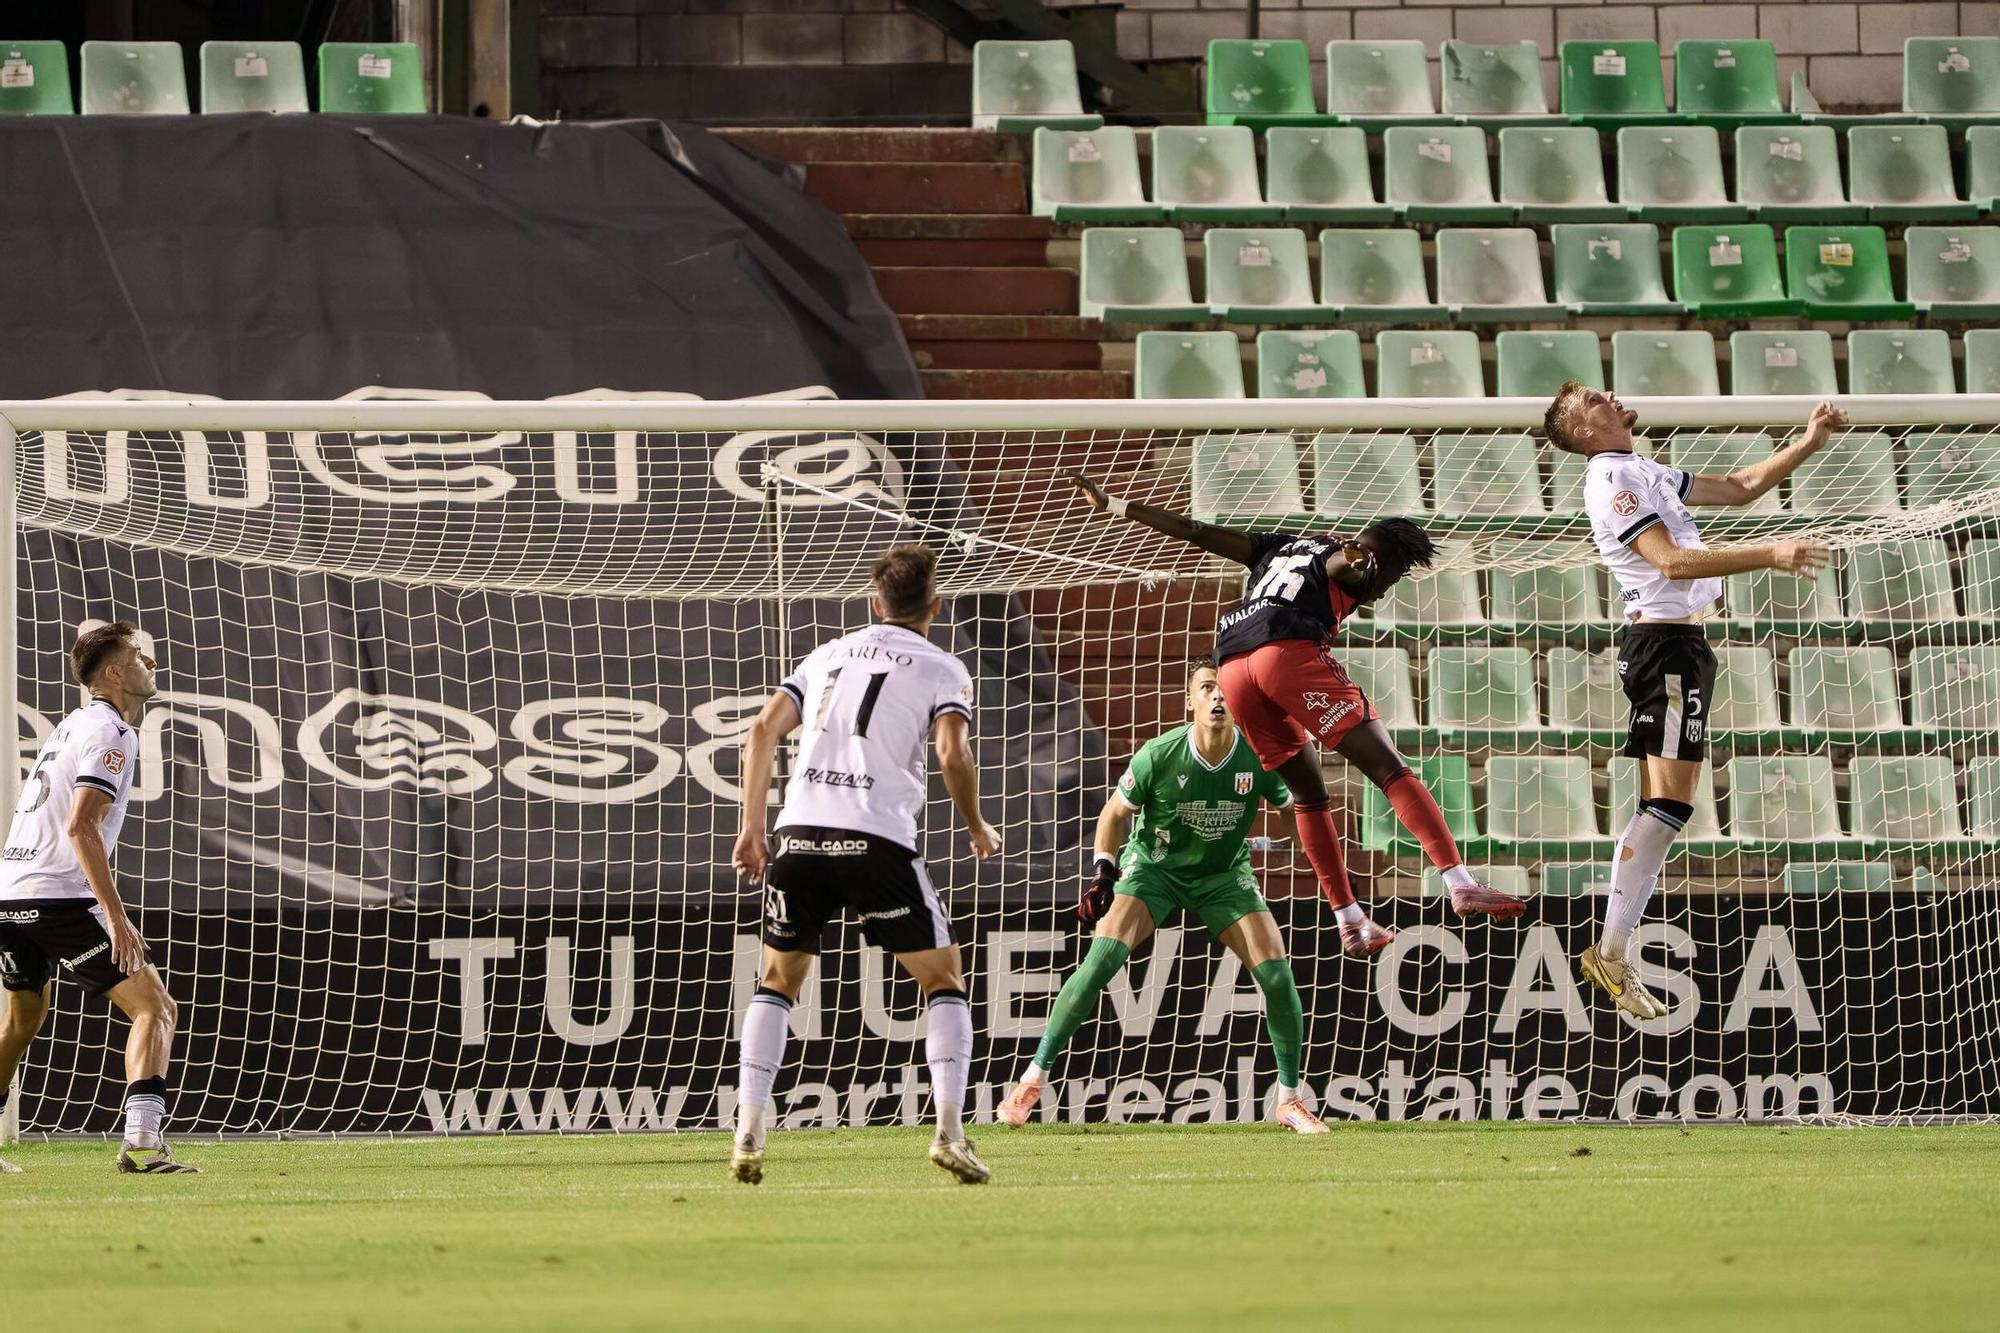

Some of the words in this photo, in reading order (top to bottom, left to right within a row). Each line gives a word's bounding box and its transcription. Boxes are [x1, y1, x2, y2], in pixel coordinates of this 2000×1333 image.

[1225, 598, 1285, 626] VALCAR
[813, 666, 890, 740] 11
[1687, 688, 1702, 716] 5
[429, 936, 634, 1046] TU
[1375, 923, 1823, 1036] CASA
